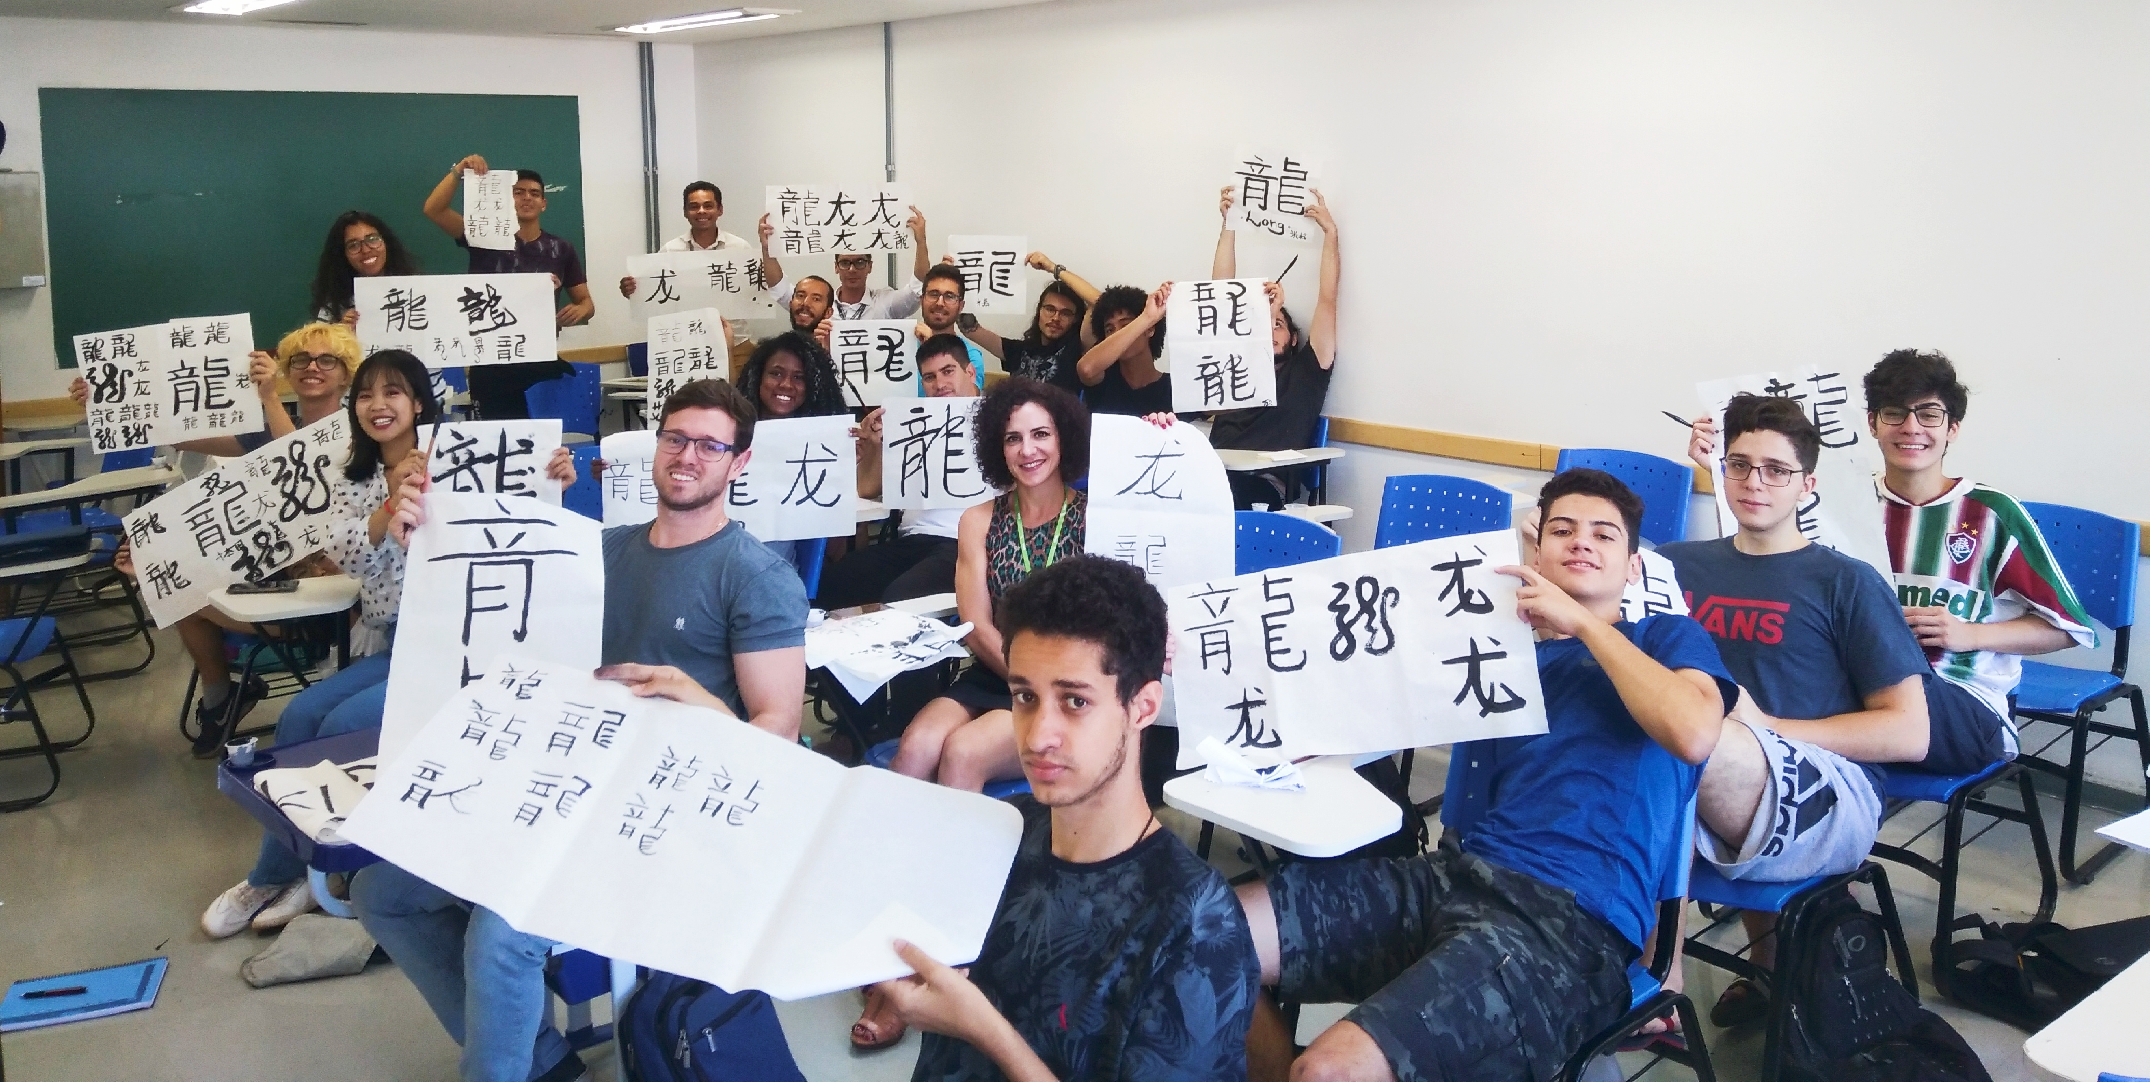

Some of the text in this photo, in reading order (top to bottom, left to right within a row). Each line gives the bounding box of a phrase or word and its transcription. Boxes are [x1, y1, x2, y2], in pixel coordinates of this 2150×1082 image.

[776, 187, 821, 227] 龍
[823, 191, 858, 227] 龙
[861, 191, 901, 228] 龙
[1233, 154, 1309, 216] 龍
[779, 226, 825, 255] 龍
[830, 228, 857, 252] 龙
[644, 268, 681, 304] 龙
[707, 260, 741, 294] 龍
[953, 250, 1017, 297] 龍
[379, 288, 429, 333] 龍
[1188, 281, 1253, 336] 龍
[836, 327, 913, 386] 龍
[1193, 353, 1257, 406] 龍
[167, 356, 236, 417] 龍
[780, 441, 842, 508] 龙
[888, 403, 987, 498] 龍
[1114, 440, 1186, 501] 龙
[180, 480, 262, 558] 龍
[1430, 545, 1495, 618] 龙
[1183, 574, 1307, 676] 龍
[1684, 589, 1791, 645] VANS
[1441, 636, 1527, 718] 龙
[1224, 686, 1283, 749] 龙
